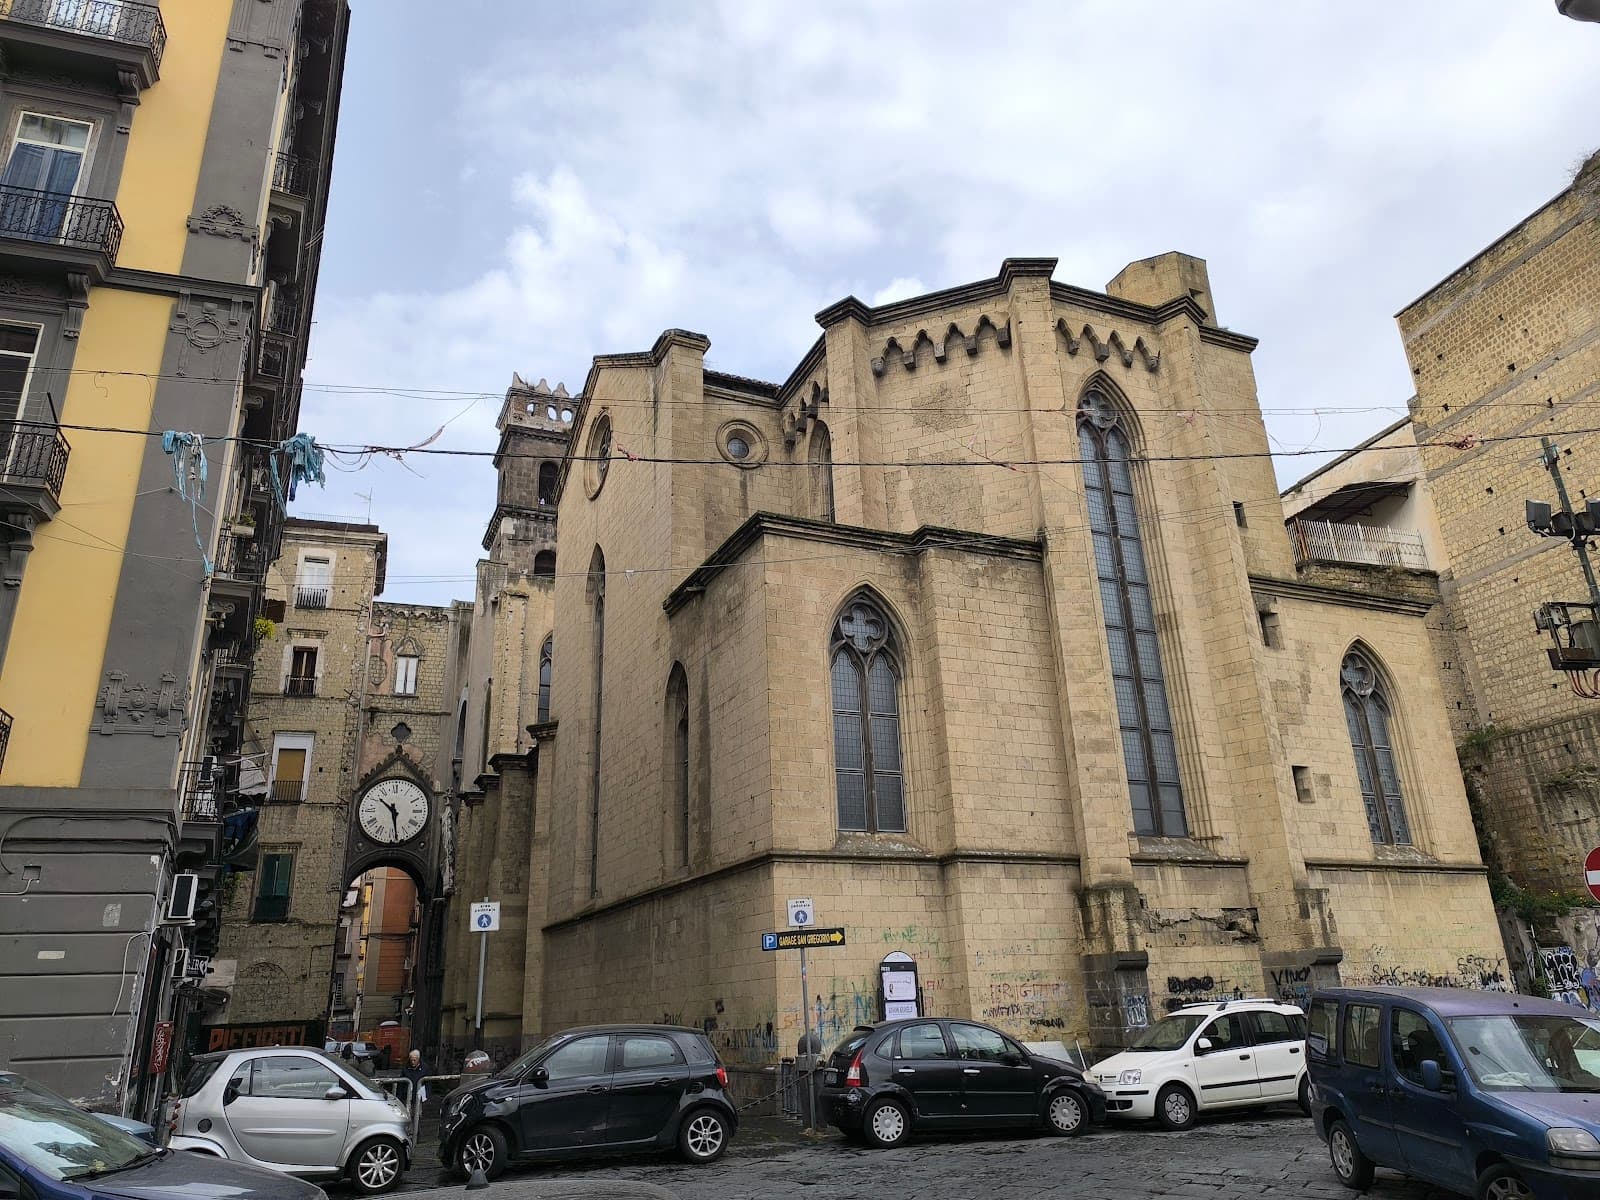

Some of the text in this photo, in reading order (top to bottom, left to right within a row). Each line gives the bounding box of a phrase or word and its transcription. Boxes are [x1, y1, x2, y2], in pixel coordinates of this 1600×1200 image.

[779, 935, 797, 946] GARAGE
[797, 934, 807, 945] SAN
[807, 933, 831, 944] GREGORIO
